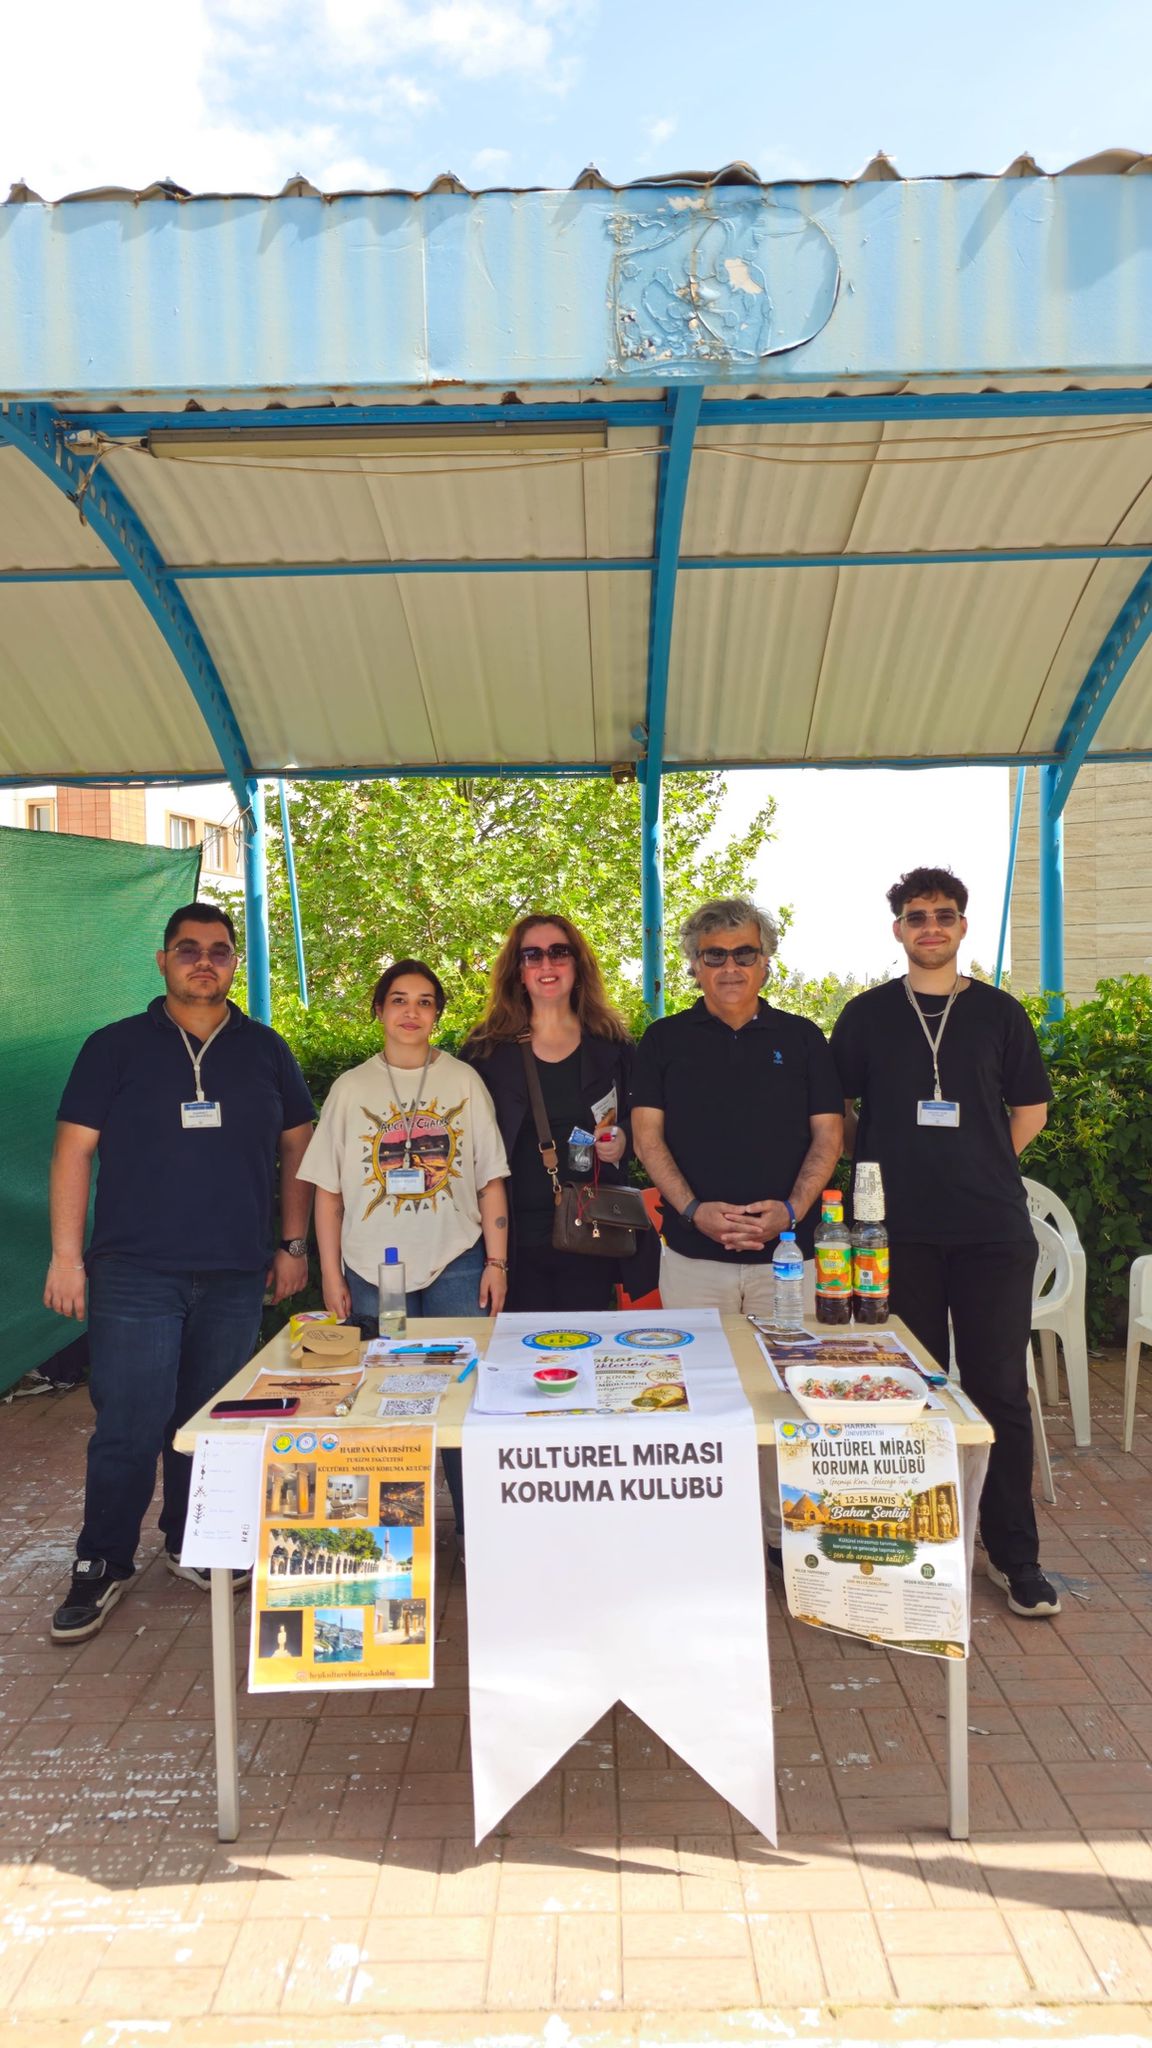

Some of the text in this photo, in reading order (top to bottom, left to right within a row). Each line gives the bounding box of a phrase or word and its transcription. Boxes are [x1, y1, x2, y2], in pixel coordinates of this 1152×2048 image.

[498, 1442, 723, 1470] KÜLTÜREL MİRASI
[811, 1437, 926, 1457] KÜLTÜREL MİRASI
[812, 1456, 925, 1475] KORUMA KULÜBÜ
[500, 1476, 723, 1503] KORUMA KULÜBÜ
[845, 1496, 896, 1504] 12-15 MAYIS
[831, 1506, 911, 1522] Bahar Şenliği
